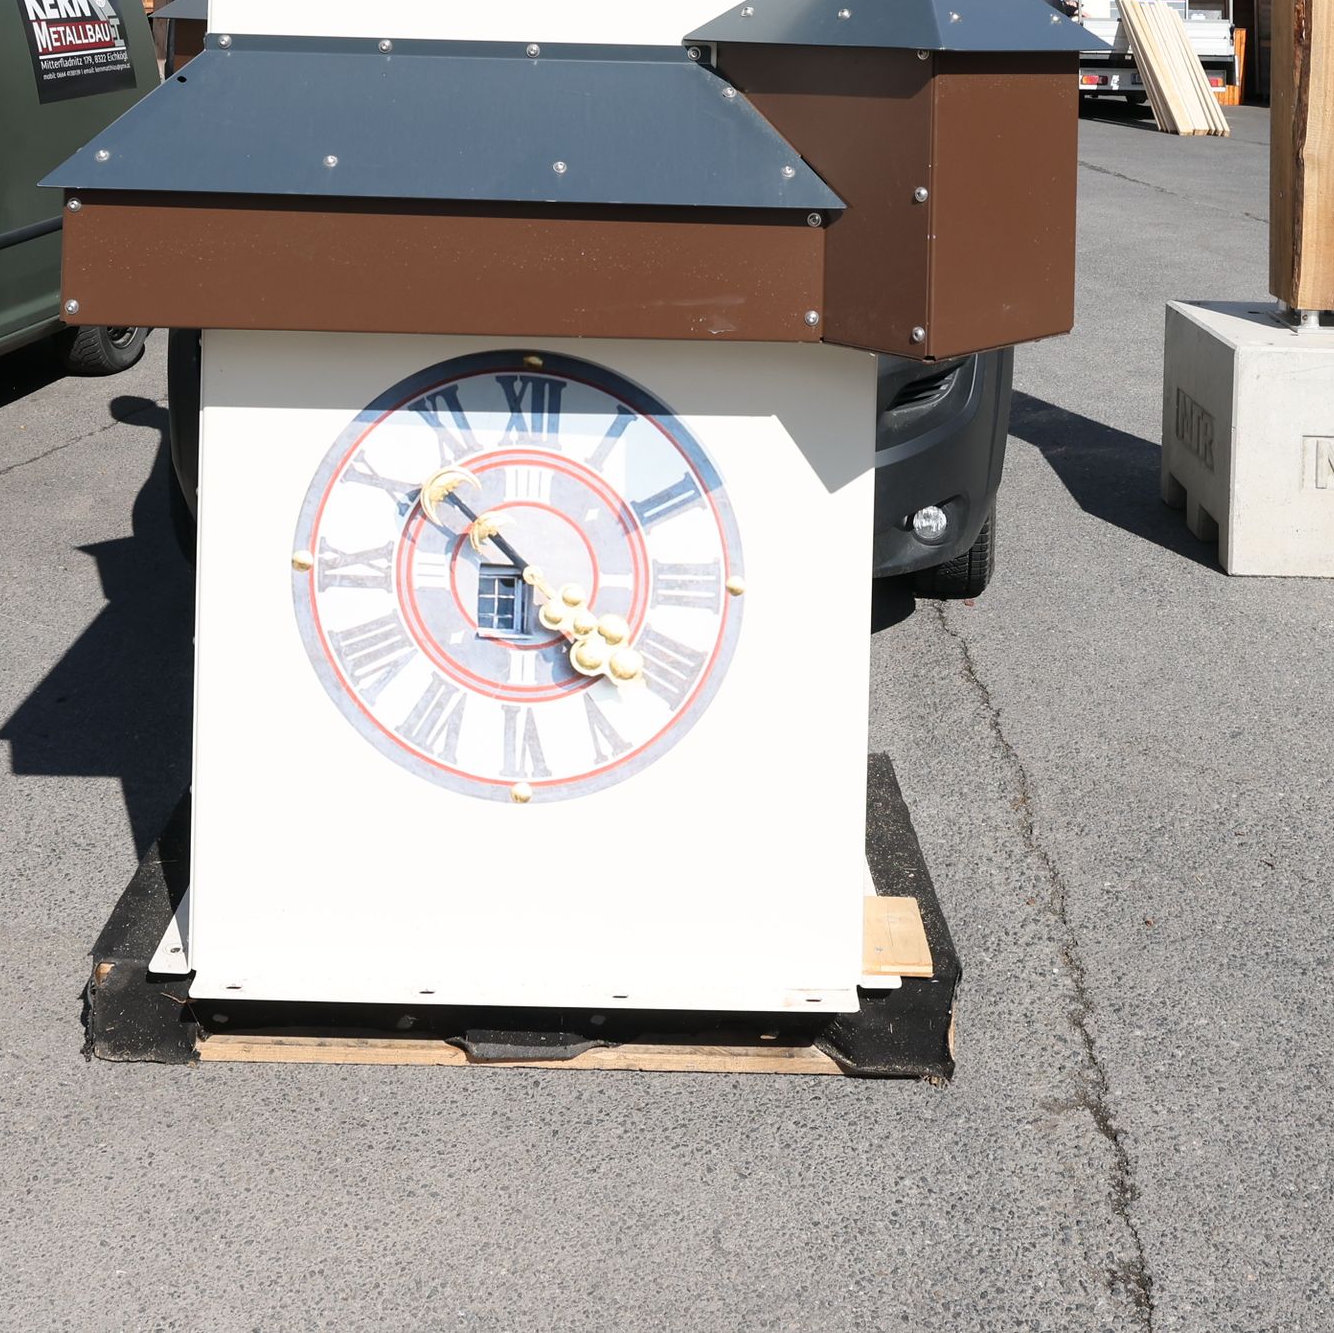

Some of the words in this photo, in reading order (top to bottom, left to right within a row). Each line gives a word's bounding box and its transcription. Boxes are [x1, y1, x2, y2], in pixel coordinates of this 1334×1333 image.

[407, 384, 484, 468] XI
[495, 374, 567, 451] XII
[1179, 390, 1215, 475] MTR
[629, 471, 709, 535] II
[317, 536, 395, 593] IX
[650, 557, 722, 615] III
[327, 608, 418, 707] VIII
[394, 670, 468, 765] VII
[499, 703, 552, 778] VI
[582, 692, 633, 765] V
